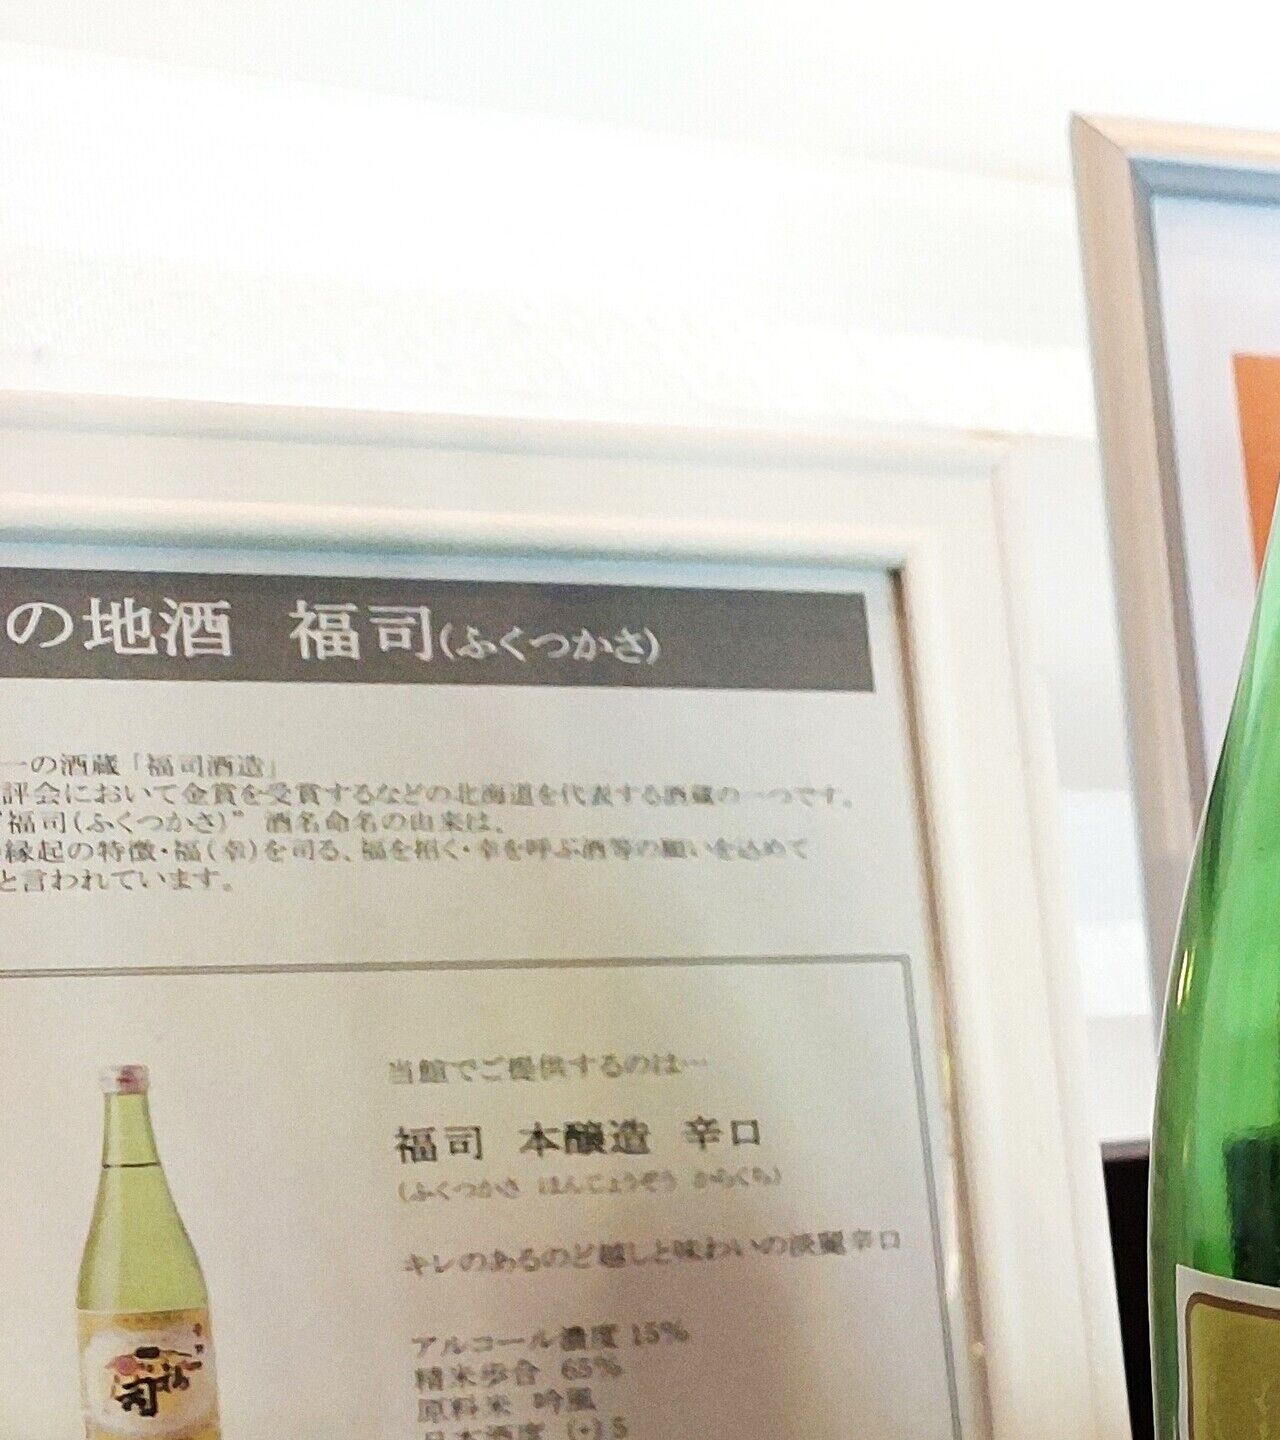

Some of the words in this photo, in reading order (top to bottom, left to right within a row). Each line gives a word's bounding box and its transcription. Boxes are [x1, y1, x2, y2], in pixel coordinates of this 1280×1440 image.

[6, 597, 232, 658] の地酒
[289, 599, 661, 665] 福司(ふくつかさ)
[395, 1125, 484, 1164] 福司
[684, 1115, 760, 1151] 辛口
